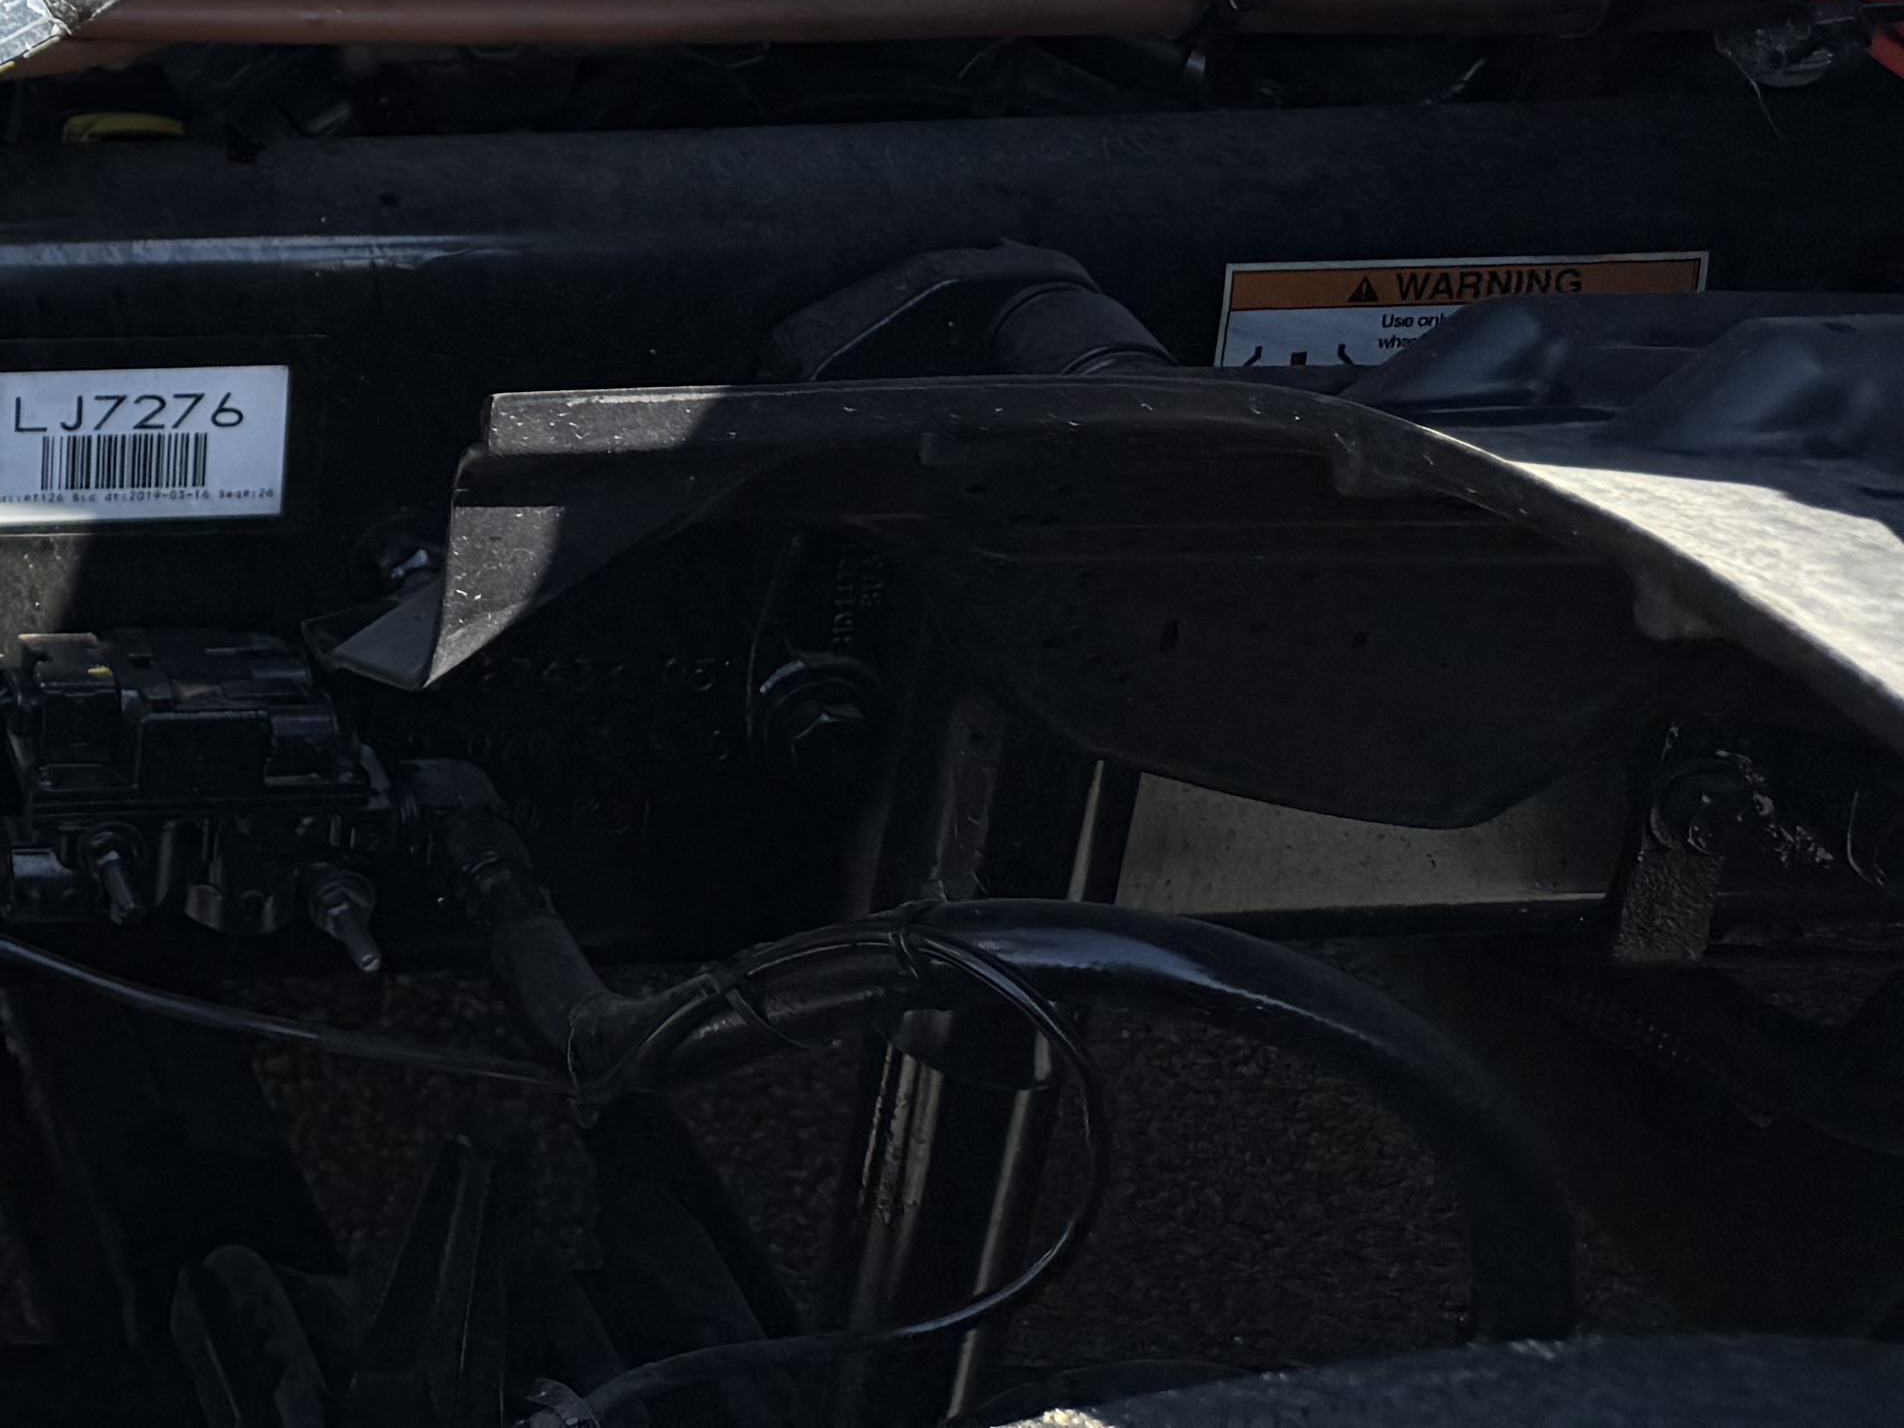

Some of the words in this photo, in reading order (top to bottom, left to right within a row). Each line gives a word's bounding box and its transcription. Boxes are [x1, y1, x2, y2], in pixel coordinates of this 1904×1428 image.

[1396, 269, 1582, 301] WARNING
[1382, 314, 1414, 328] Use
[14, 392, 244, 434] LJ7276
